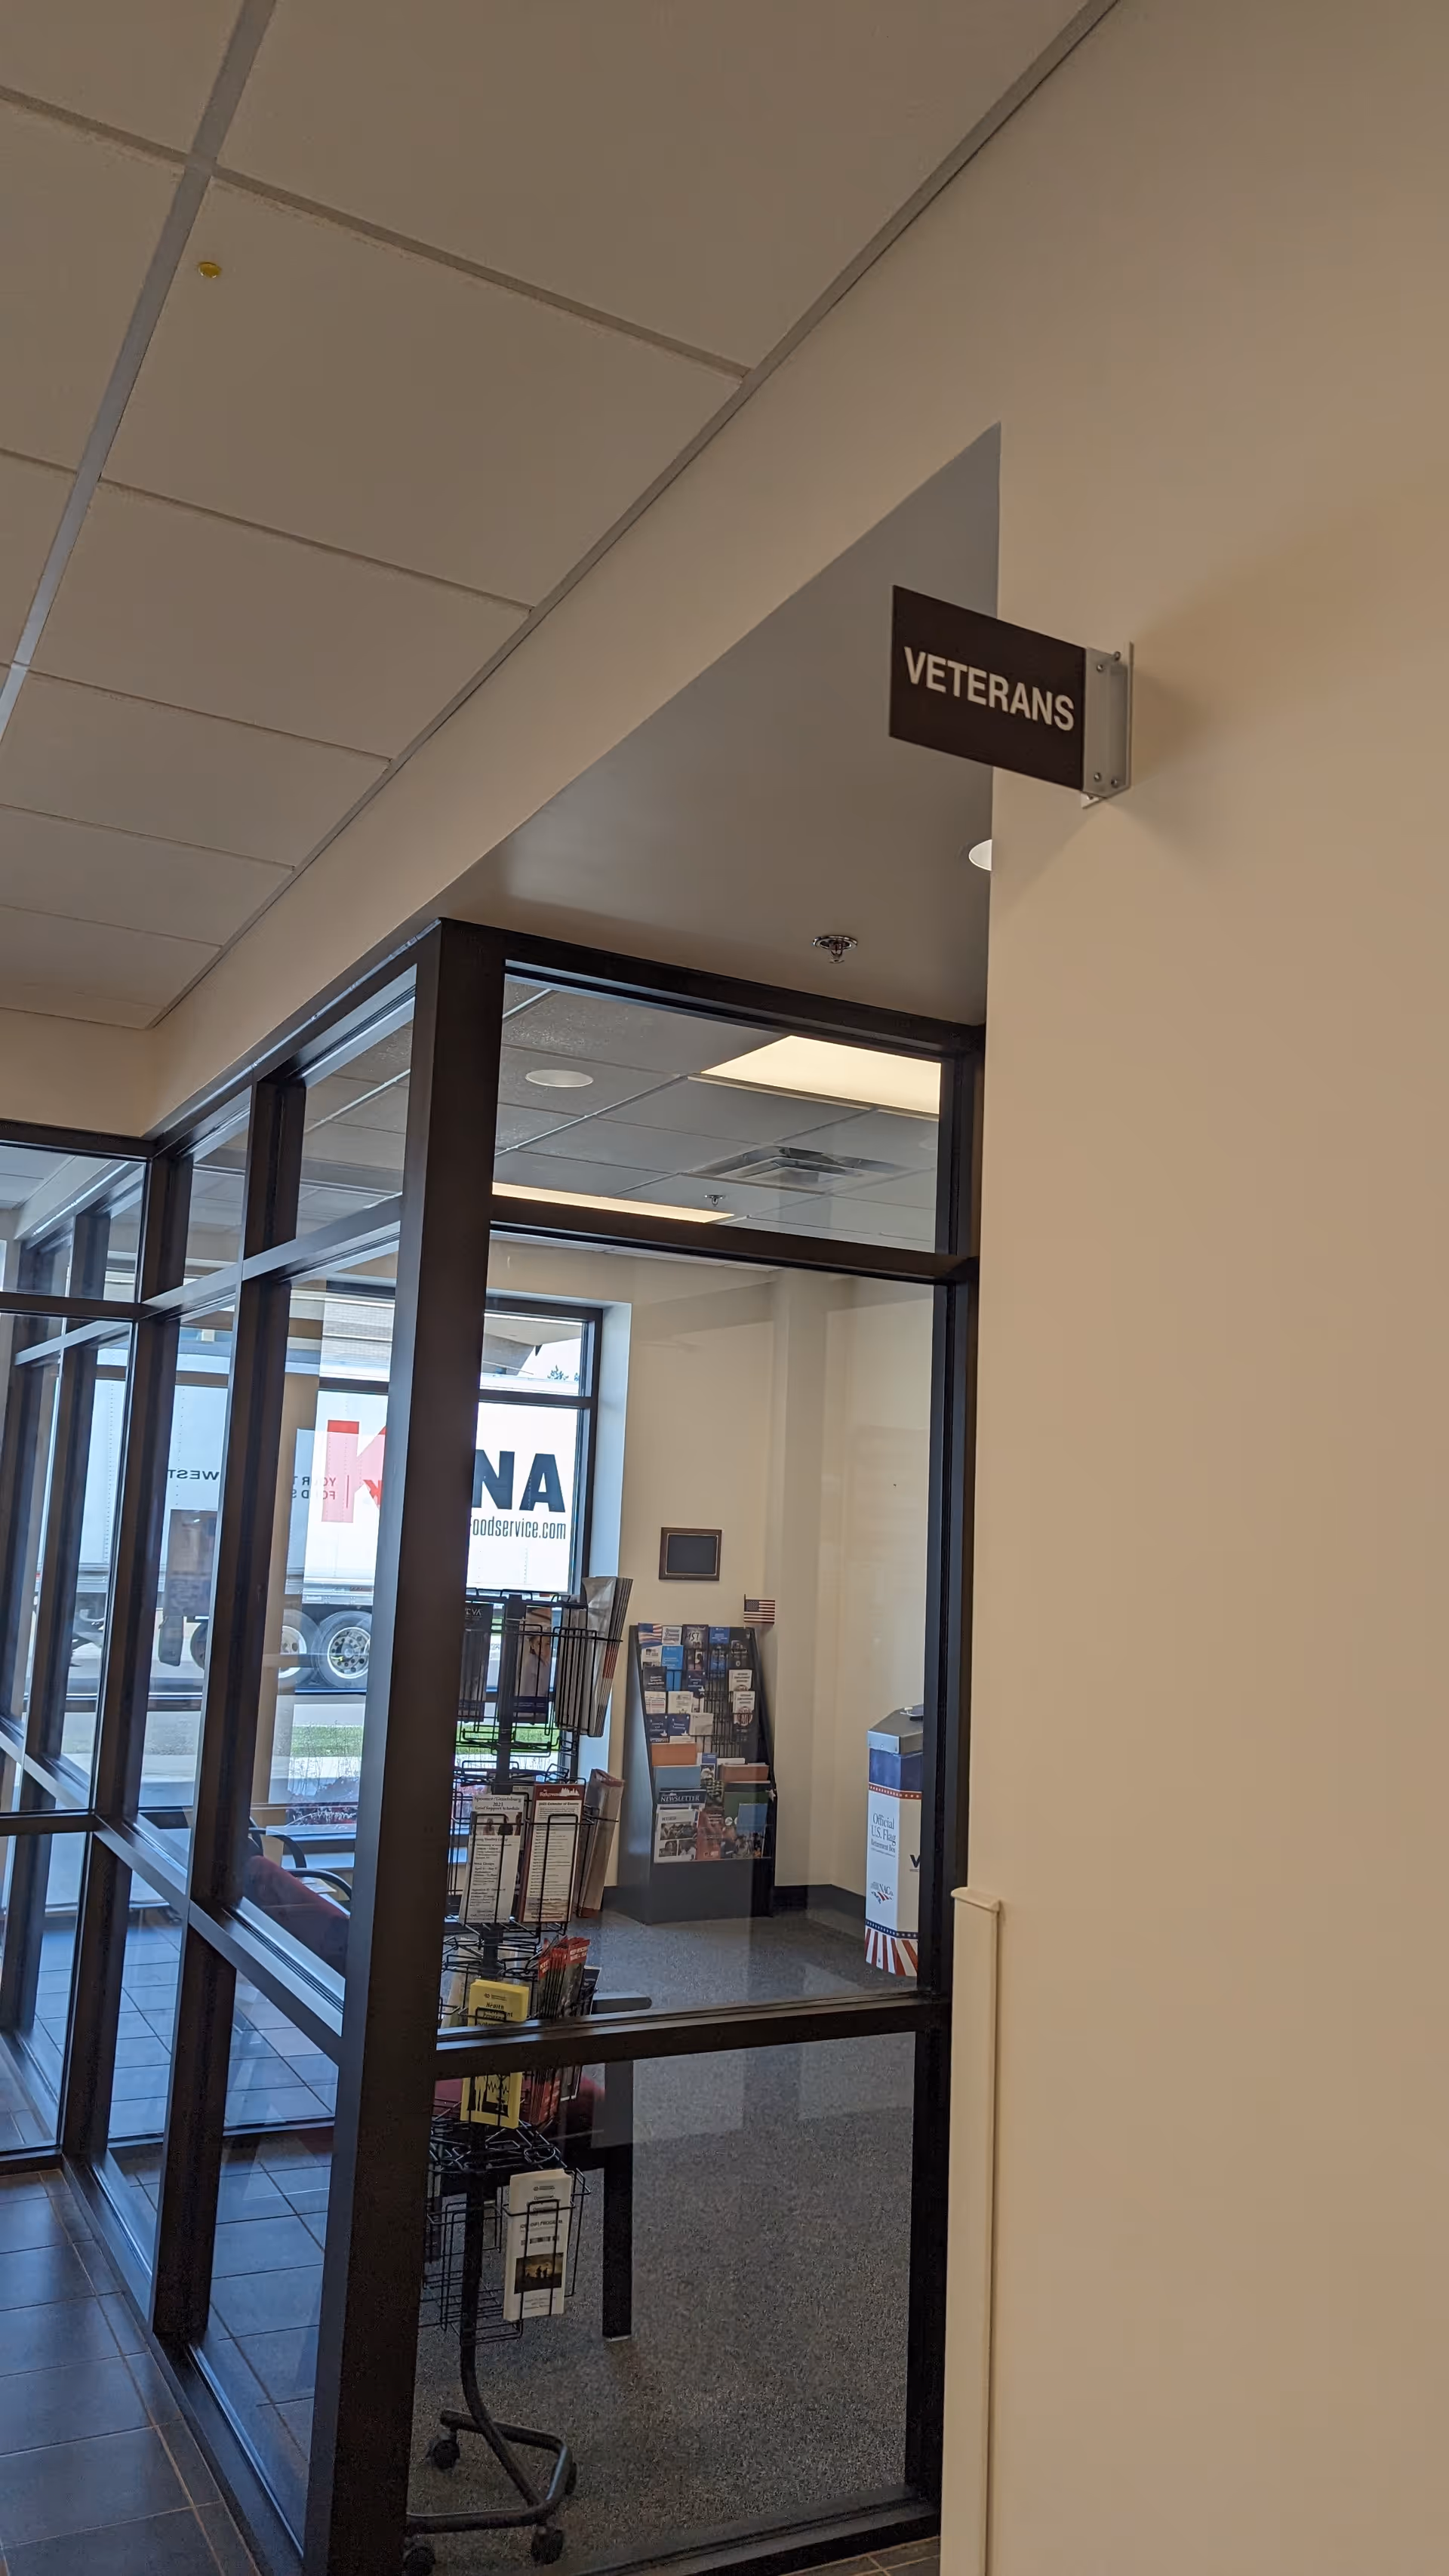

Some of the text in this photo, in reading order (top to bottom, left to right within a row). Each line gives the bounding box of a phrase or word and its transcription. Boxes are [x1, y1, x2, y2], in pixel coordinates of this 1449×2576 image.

[904, 646, 1075, 731] VETERANS
[472, 1449, 566, 1513] NA
[660, 1794, 700, 1803] NEWSLETTER
[872, 1813, 894, 1830] Official
[871, 1824, 897, 1847] U.S. Flag
